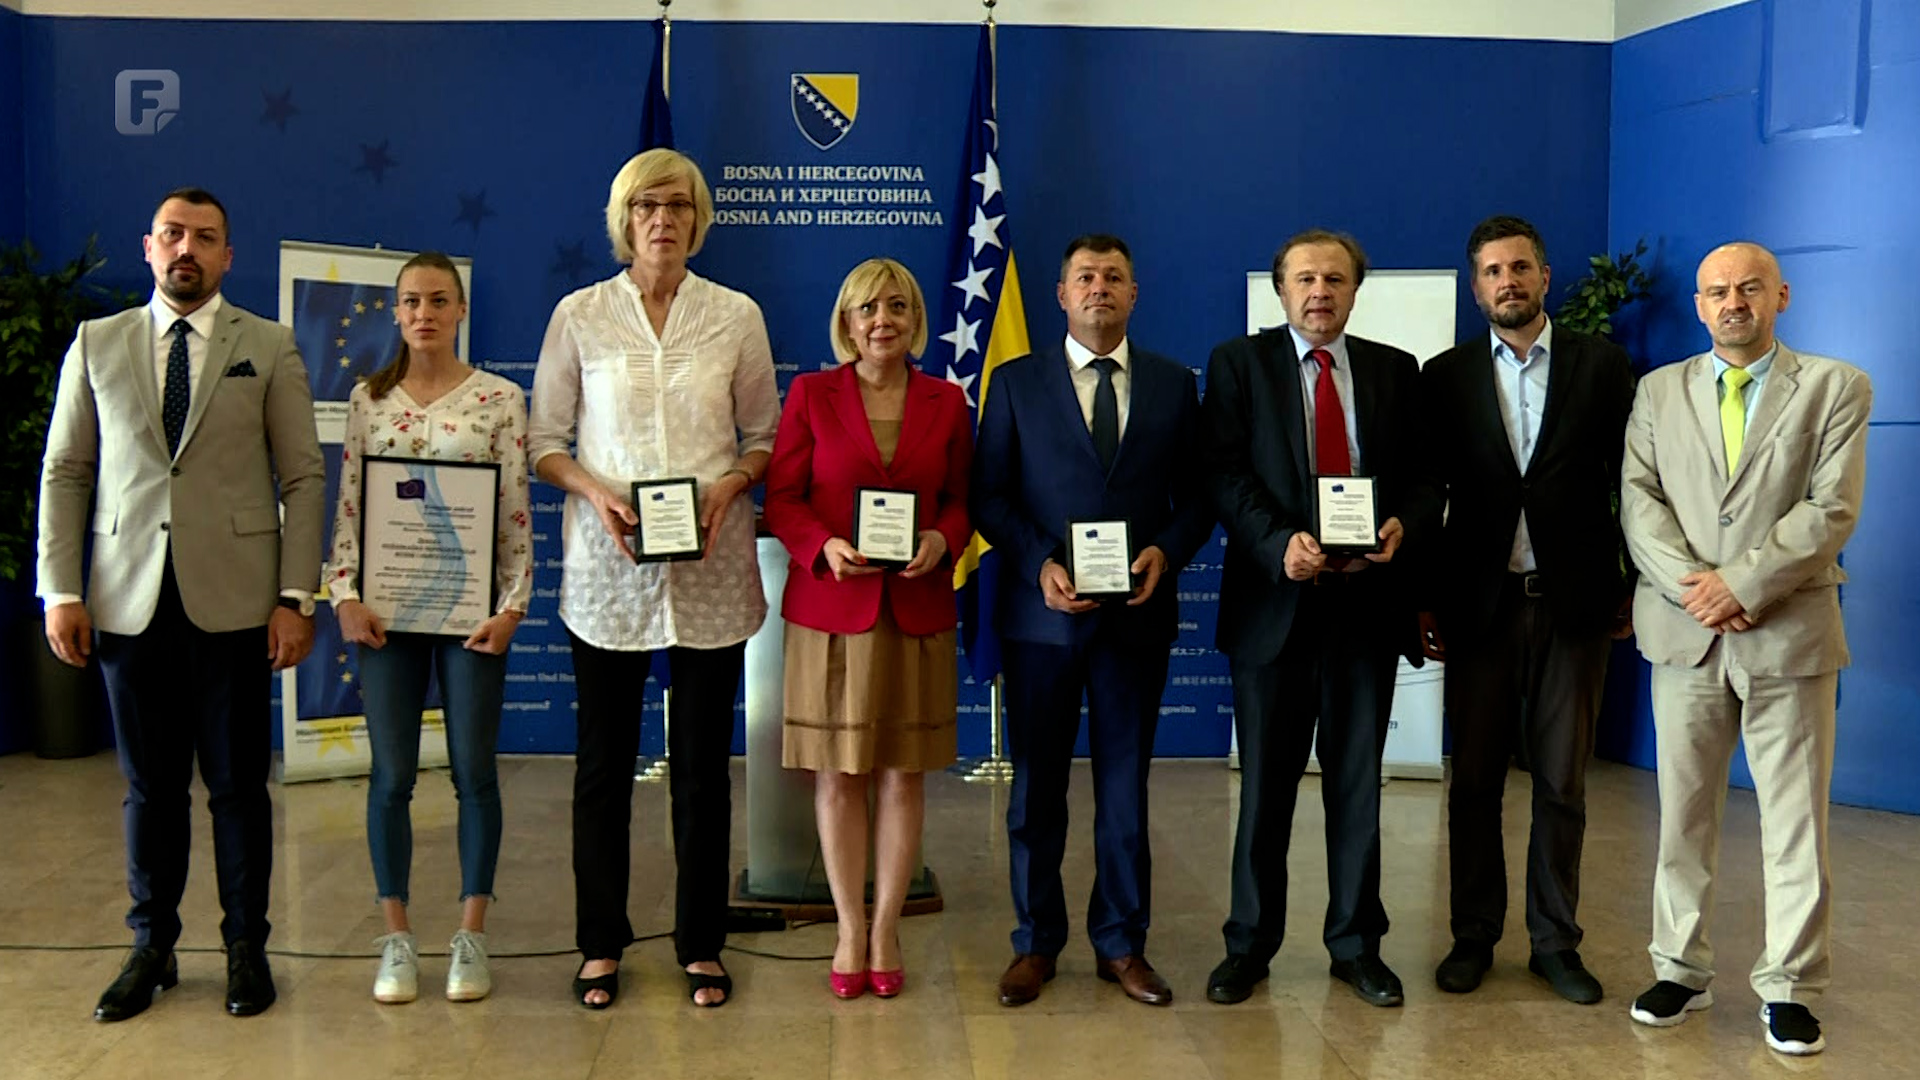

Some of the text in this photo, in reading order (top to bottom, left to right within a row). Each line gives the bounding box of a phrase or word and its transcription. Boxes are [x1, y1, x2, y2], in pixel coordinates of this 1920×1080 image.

[723, 165, 924, 182] BOSNA I HERCEGOVINA
[714, 187, 933, 206] БОСНА И ХЕРЦЕГОВИНА
[712, 208, 944, 226] OSNIA AND HERZEGOVINA
